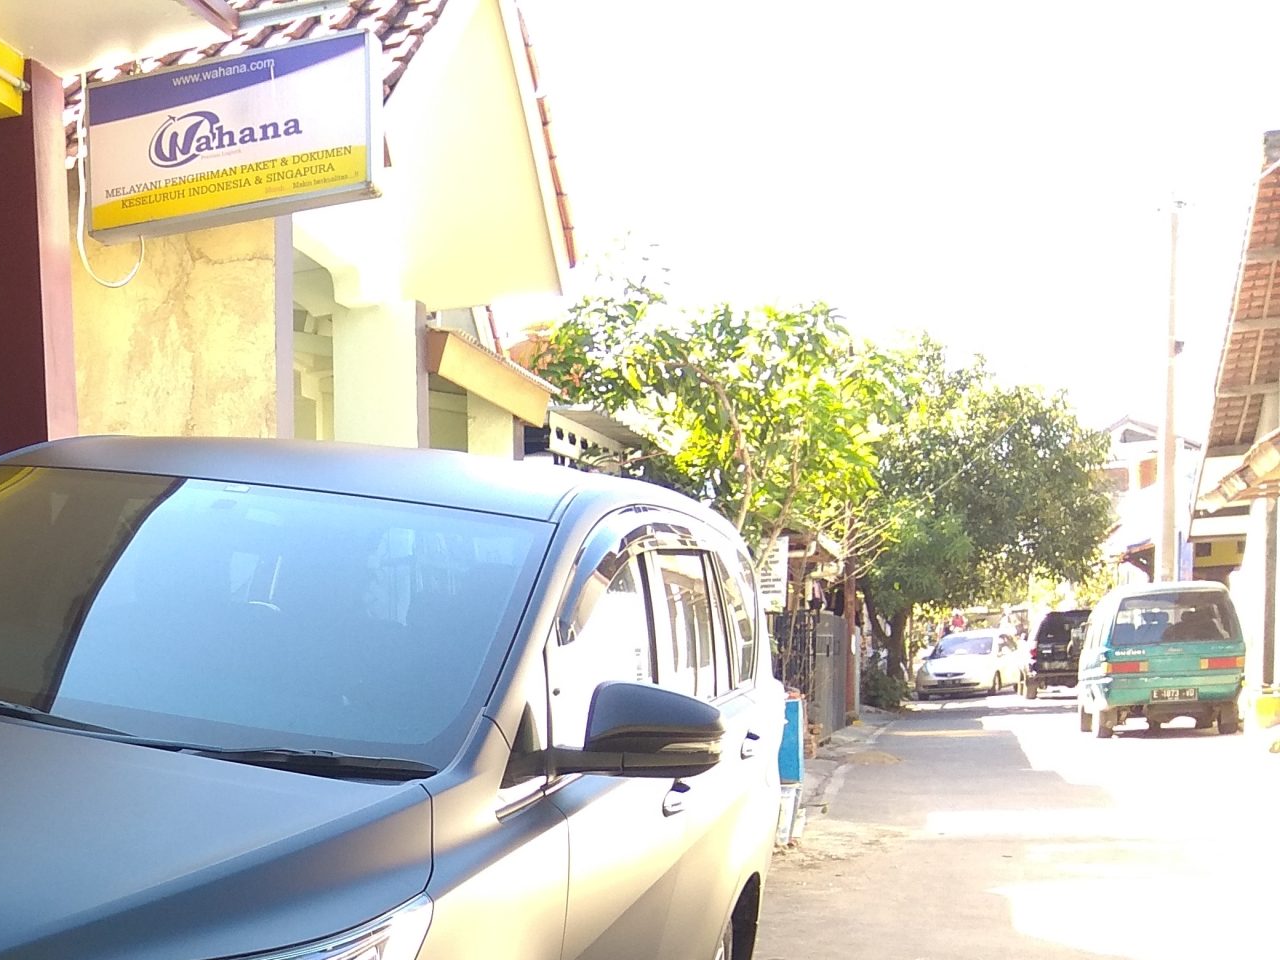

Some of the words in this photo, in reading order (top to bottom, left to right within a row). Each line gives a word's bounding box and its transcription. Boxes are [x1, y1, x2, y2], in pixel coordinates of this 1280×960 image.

[172, 58, 275, 87] www.wahana.com
[148, 110, 303, 169] Wahana
[105, 180, 162, 199] MELAYANI
[164, 163, 238, 188] PENGIRIMAN
[240, 159, 277, 175] PAKET
[280, 156, 289, 167] &
[292, 145, 353, 165] DOKUMEN
[120, 189, 186, 210] KESELURUH
[188, 178, 252, 198] INDONESIA
[254, 176, 263, 186] &
[266, 162, 335, 184] SINGAPURA
